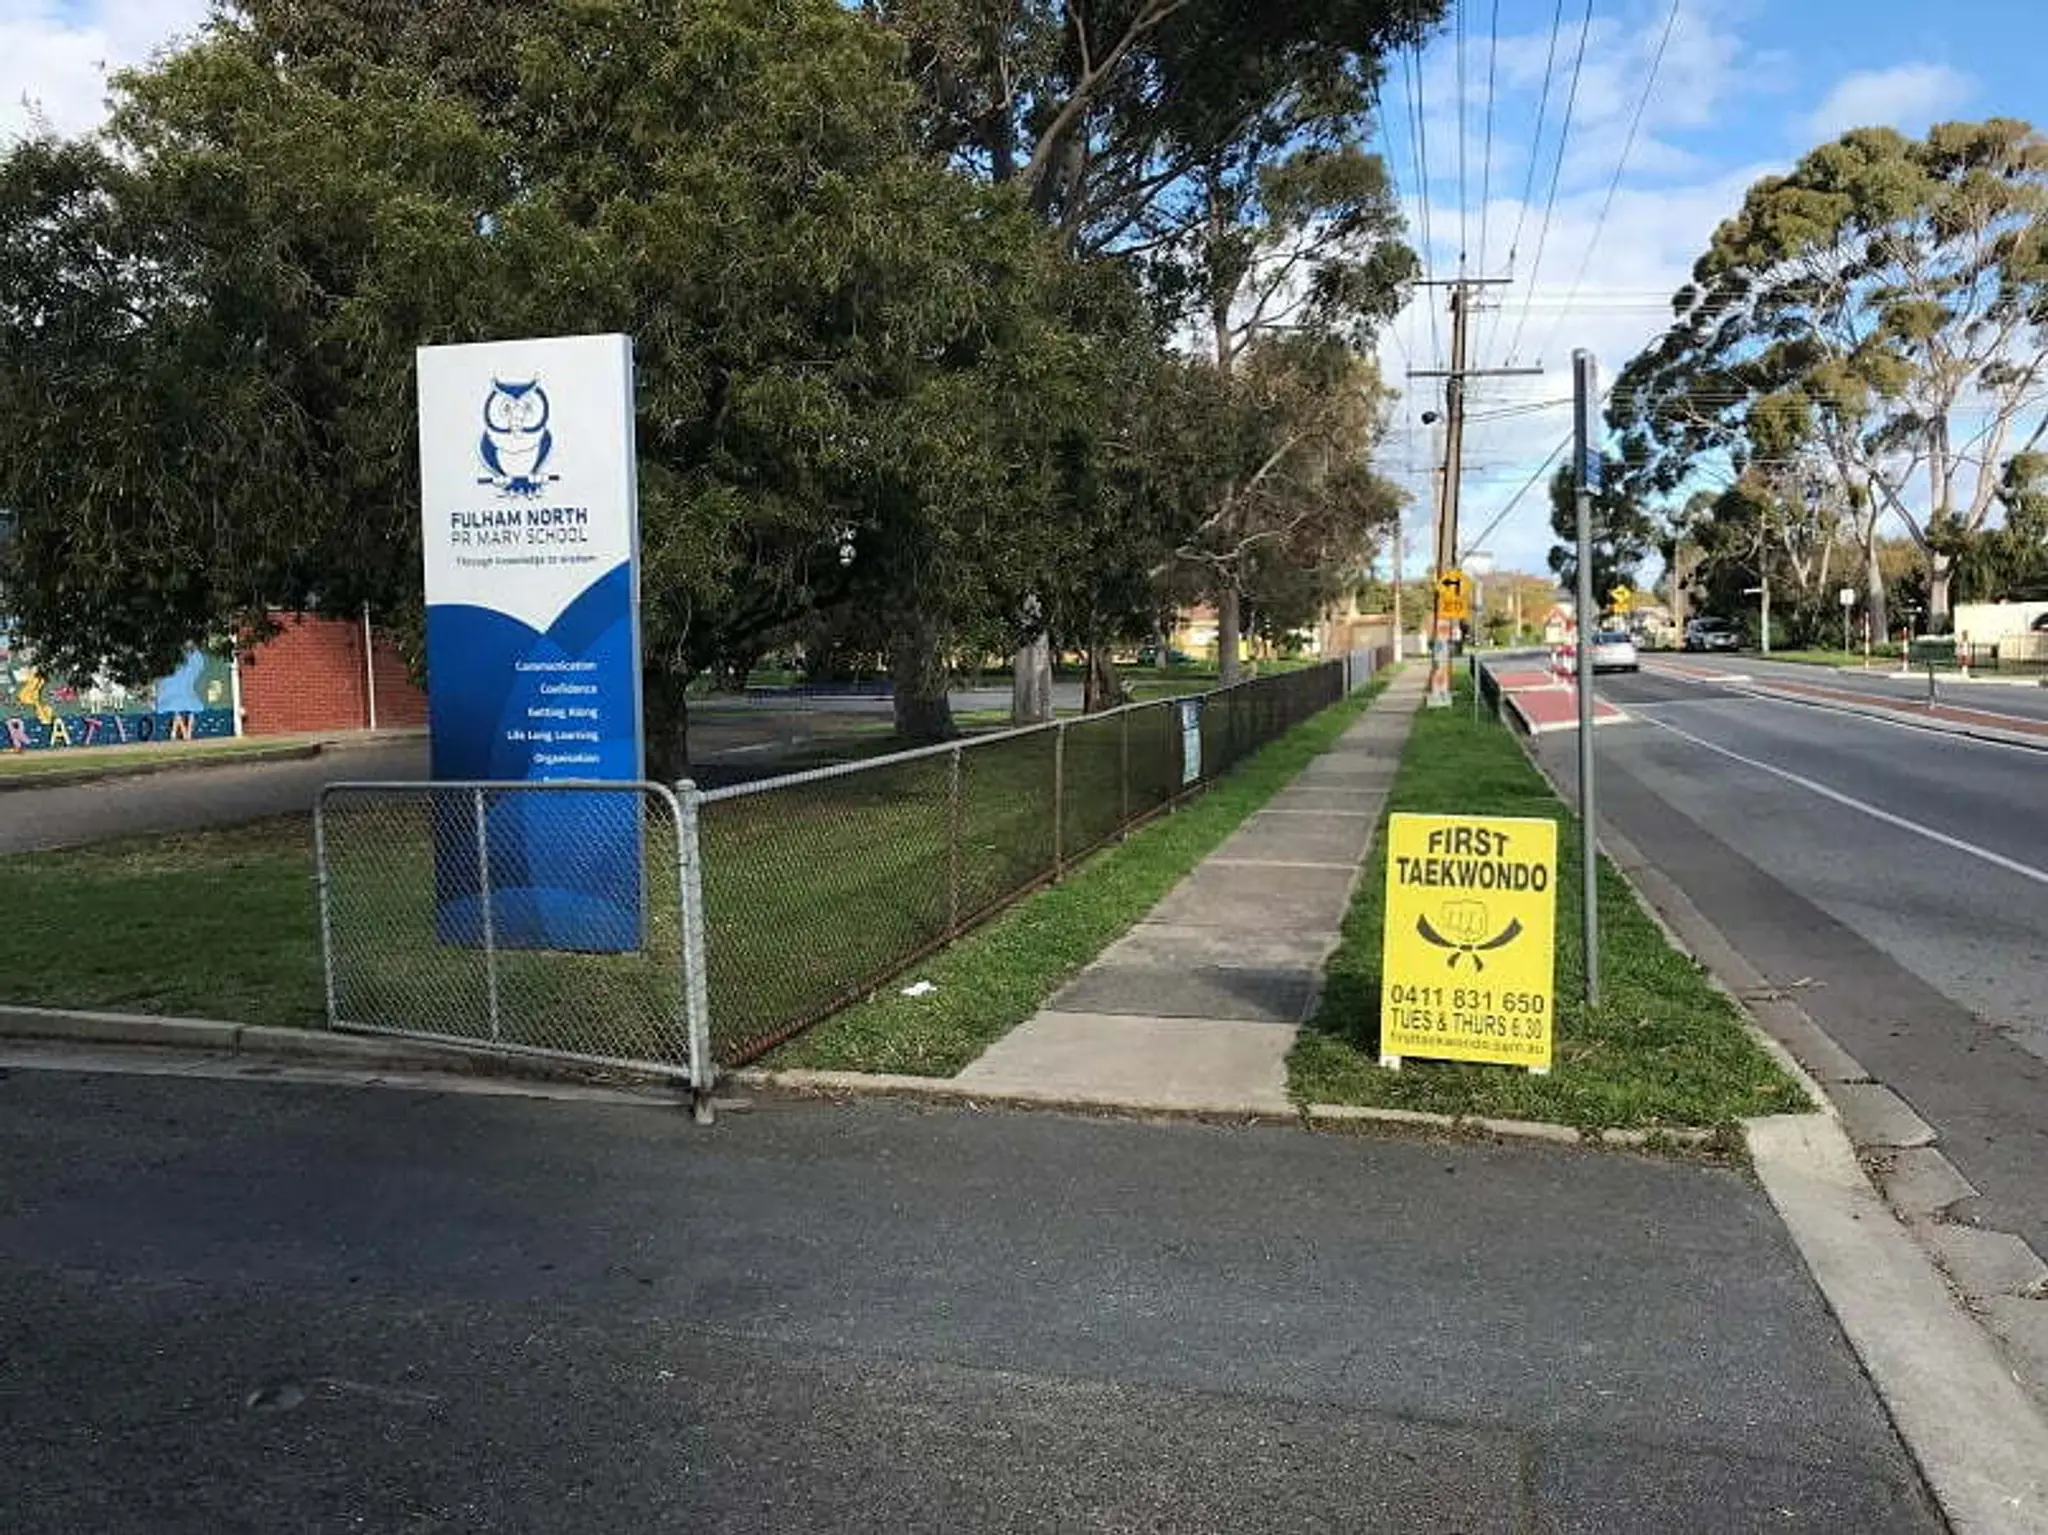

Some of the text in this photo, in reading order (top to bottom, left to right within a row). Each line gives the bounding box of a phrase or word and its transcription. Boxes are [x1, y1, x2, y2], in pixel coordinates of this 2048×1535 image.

[450, 508, 588, 528] FULHAM NORTH
[450, 527, 588, 546] PRMARY SCHOOL
[1428, 826, 1509, 857] FIRST
[1396, 856, 1548, 892] TAEKWONDO
[1390, 984, 1545, 1014] 0411 831 650
[1390, 1007, 1432, 1032] TUES
[1436, 1010, 1448, 1032] &
[1453, 1012, 1507, 1038] THURS
